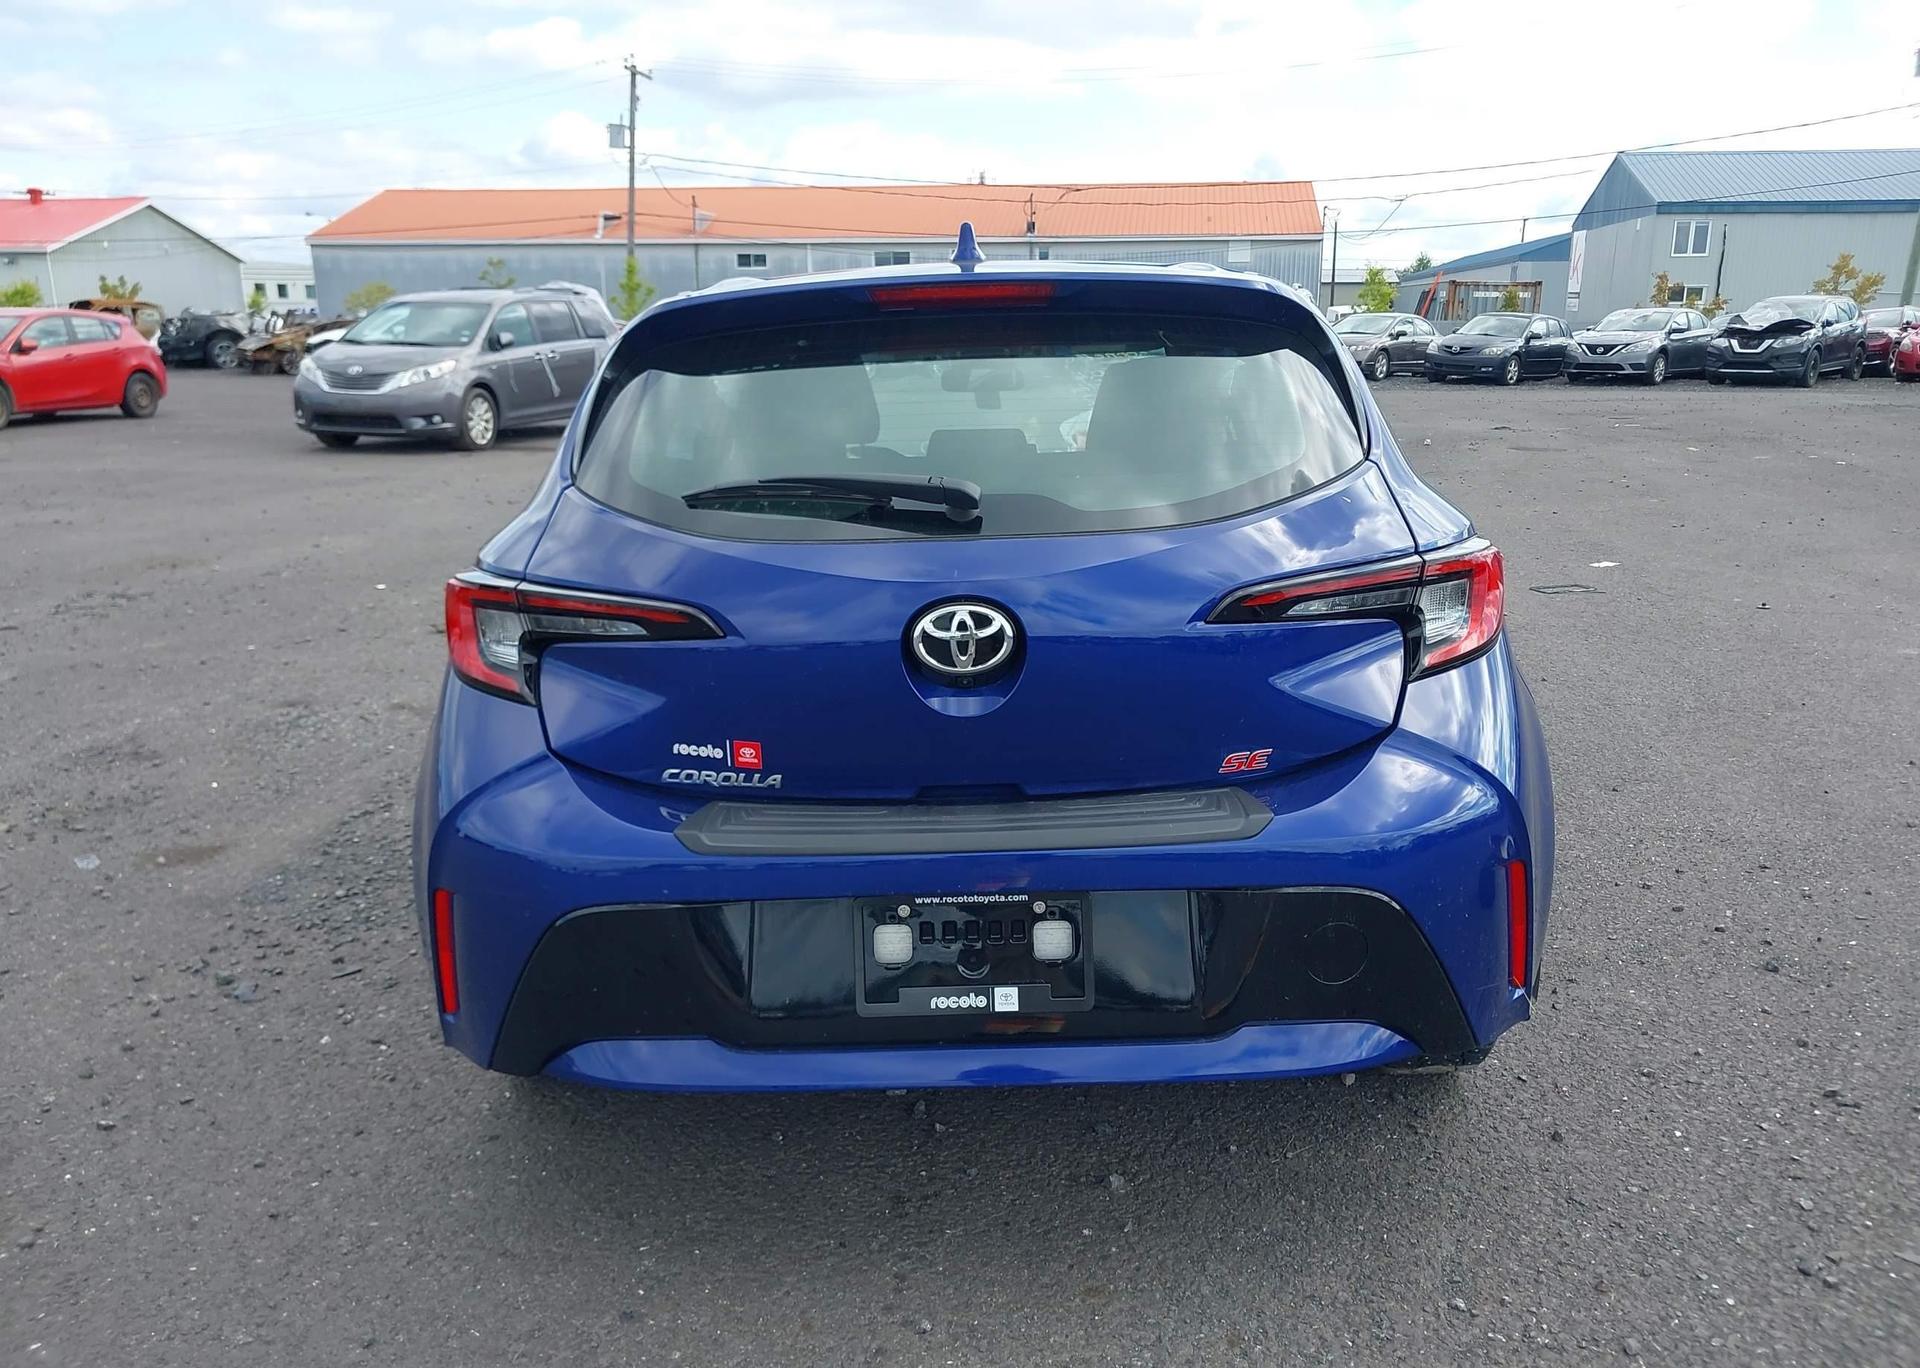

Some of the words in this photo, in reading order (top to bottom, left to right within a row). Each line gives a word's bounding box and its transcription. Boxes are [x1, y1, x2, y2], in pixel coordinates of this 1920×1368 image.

[672, 743, 724, 759] rocoto
[1218, 748, 1274, 774] SE
[661, 768, 782, 789] COROLLA
[914, 893, 1029, 904] www.rocototoyota.com
[930, 992, 988, 1009] rocoto
